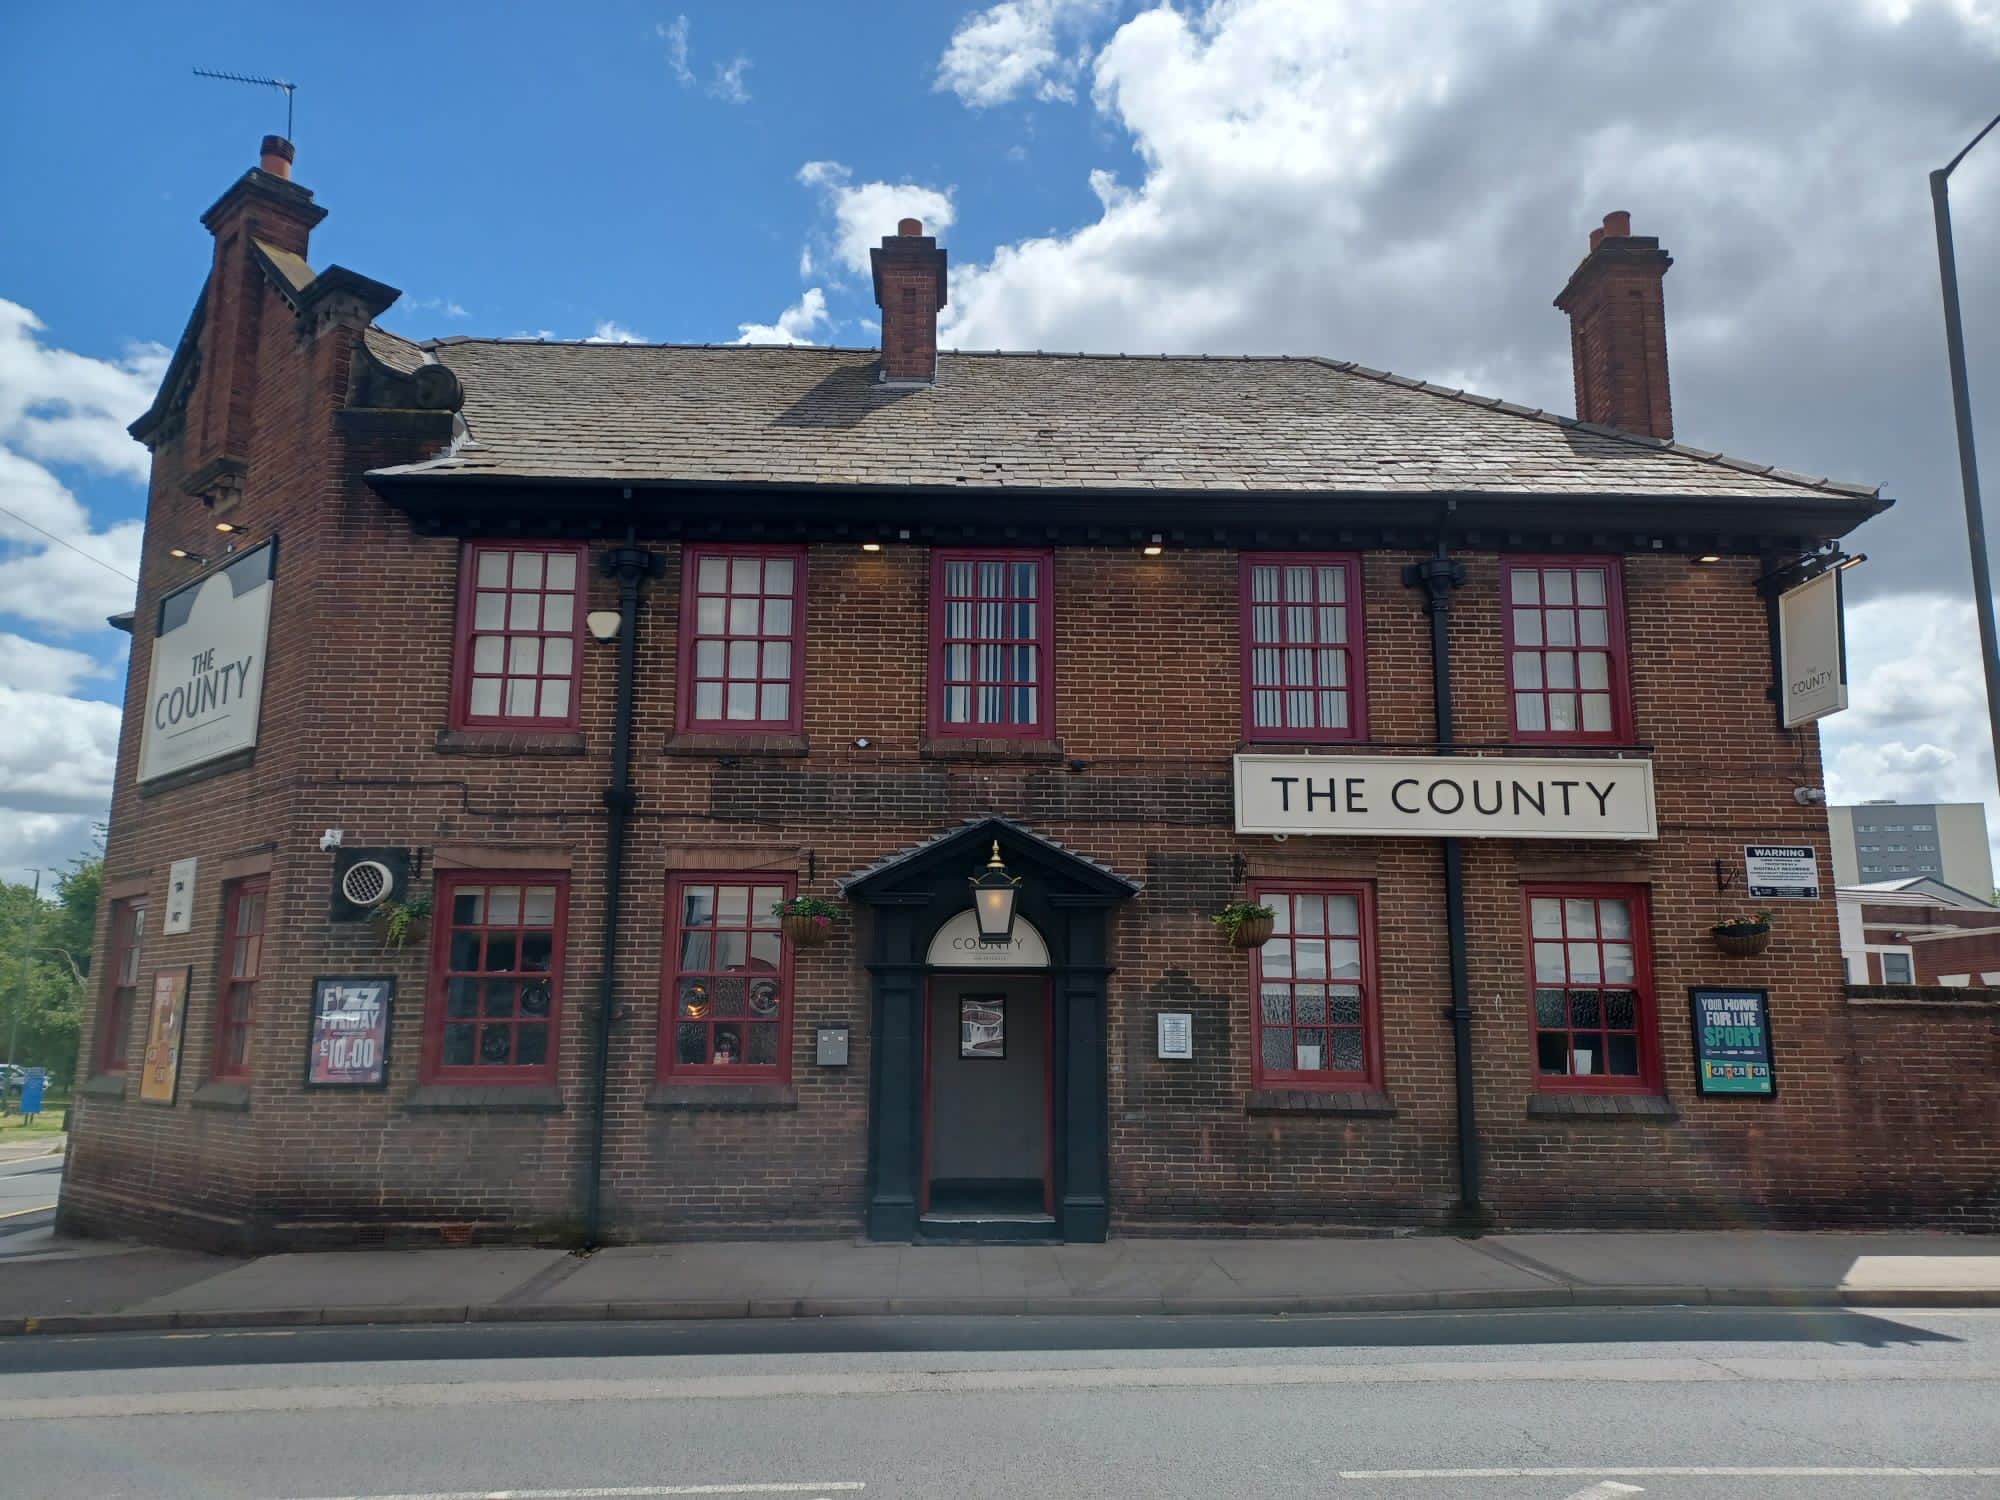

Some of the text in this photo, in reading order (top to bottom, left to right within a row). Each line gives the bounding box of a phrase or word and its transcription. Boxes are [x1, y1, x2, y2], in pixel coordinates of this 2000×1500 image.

[192, 647, 215, 677] THE
[155, 655, 253, 731] COUNTY
[1792, 669, 1833, 695] COUNTY
[1271, 776, 1617, 817] THE COUNTY
[1754, 848, 1805, 857] WARNING
[1701, 998, 1759, 1011] YOUR HOME
[1706, 1011, 1757, 1026] FOR LIVE
[1703, 1027, 1761, 1047] SPORT
